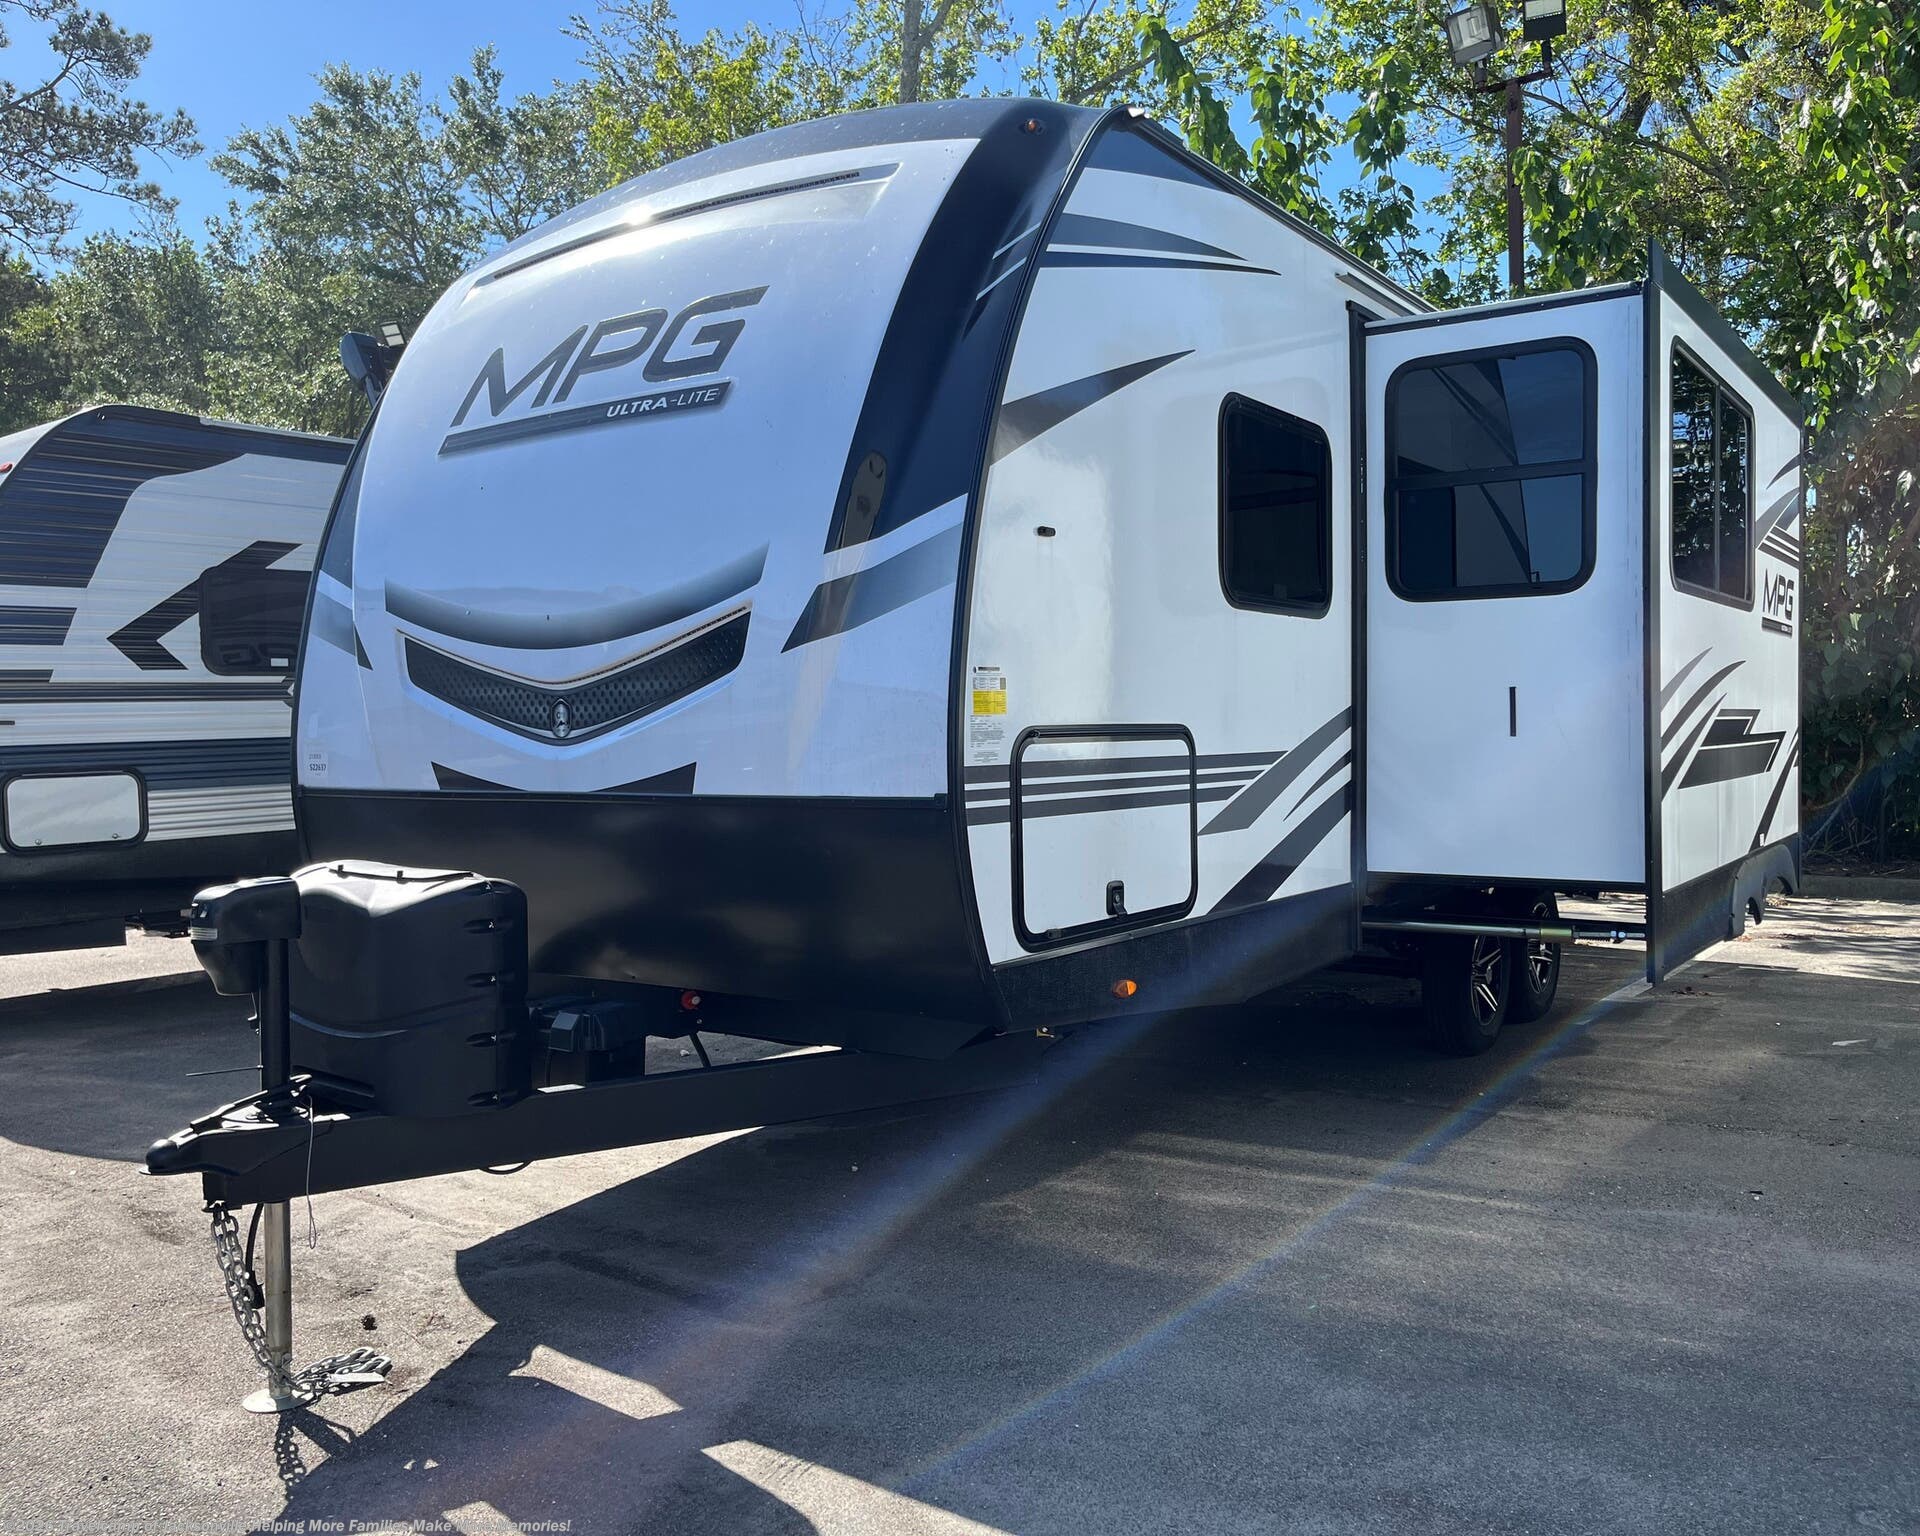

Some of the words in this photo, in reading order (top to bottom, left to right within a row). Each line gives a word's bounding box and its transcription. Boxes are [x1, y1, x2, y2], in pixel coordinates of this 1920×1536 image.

[450, 285, 770, 428] MPG
[606, 388, 719, 418] ULTRA-LITE
[1762, 568, 1795, 621] MPG
